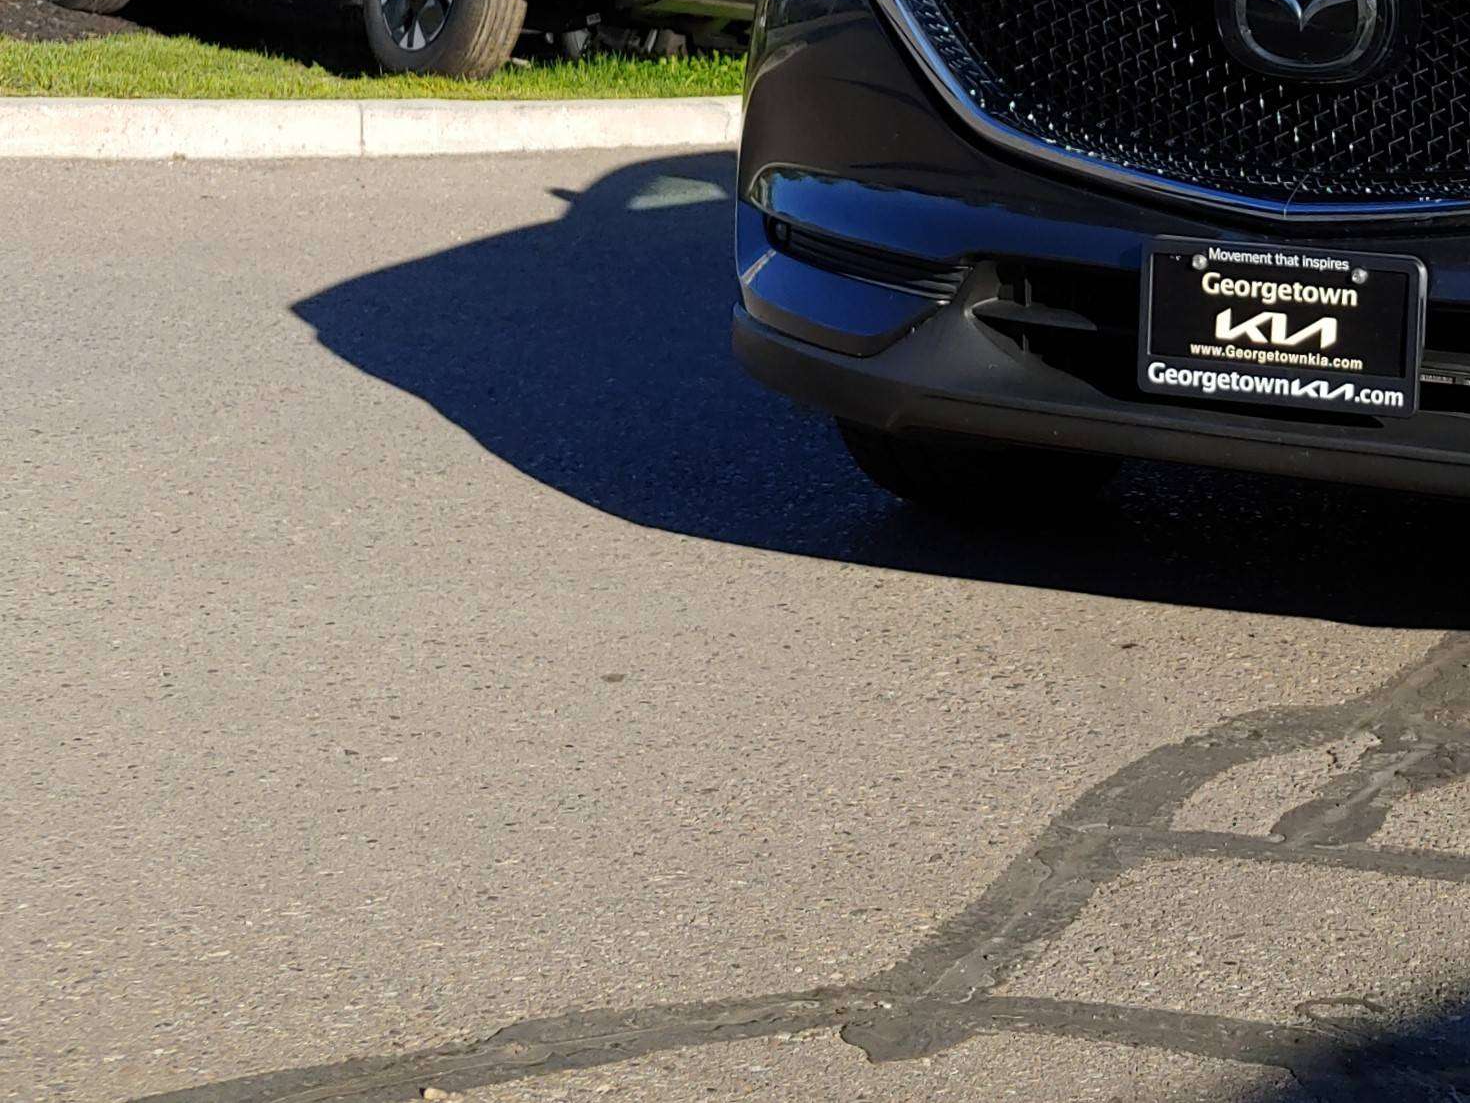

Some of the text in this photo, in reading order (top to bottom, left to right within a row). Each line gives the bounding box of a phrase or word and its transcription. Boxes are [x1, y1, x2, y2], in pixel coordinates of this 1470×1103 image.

[1207, 247, 1350, 271] Movement that inspires
[1201, 271, 1359, 307] Georgetown
[1214, 308, 1338, 349] KIA
[1190, 343, 1364, 371] www.Georgetownkia.com
